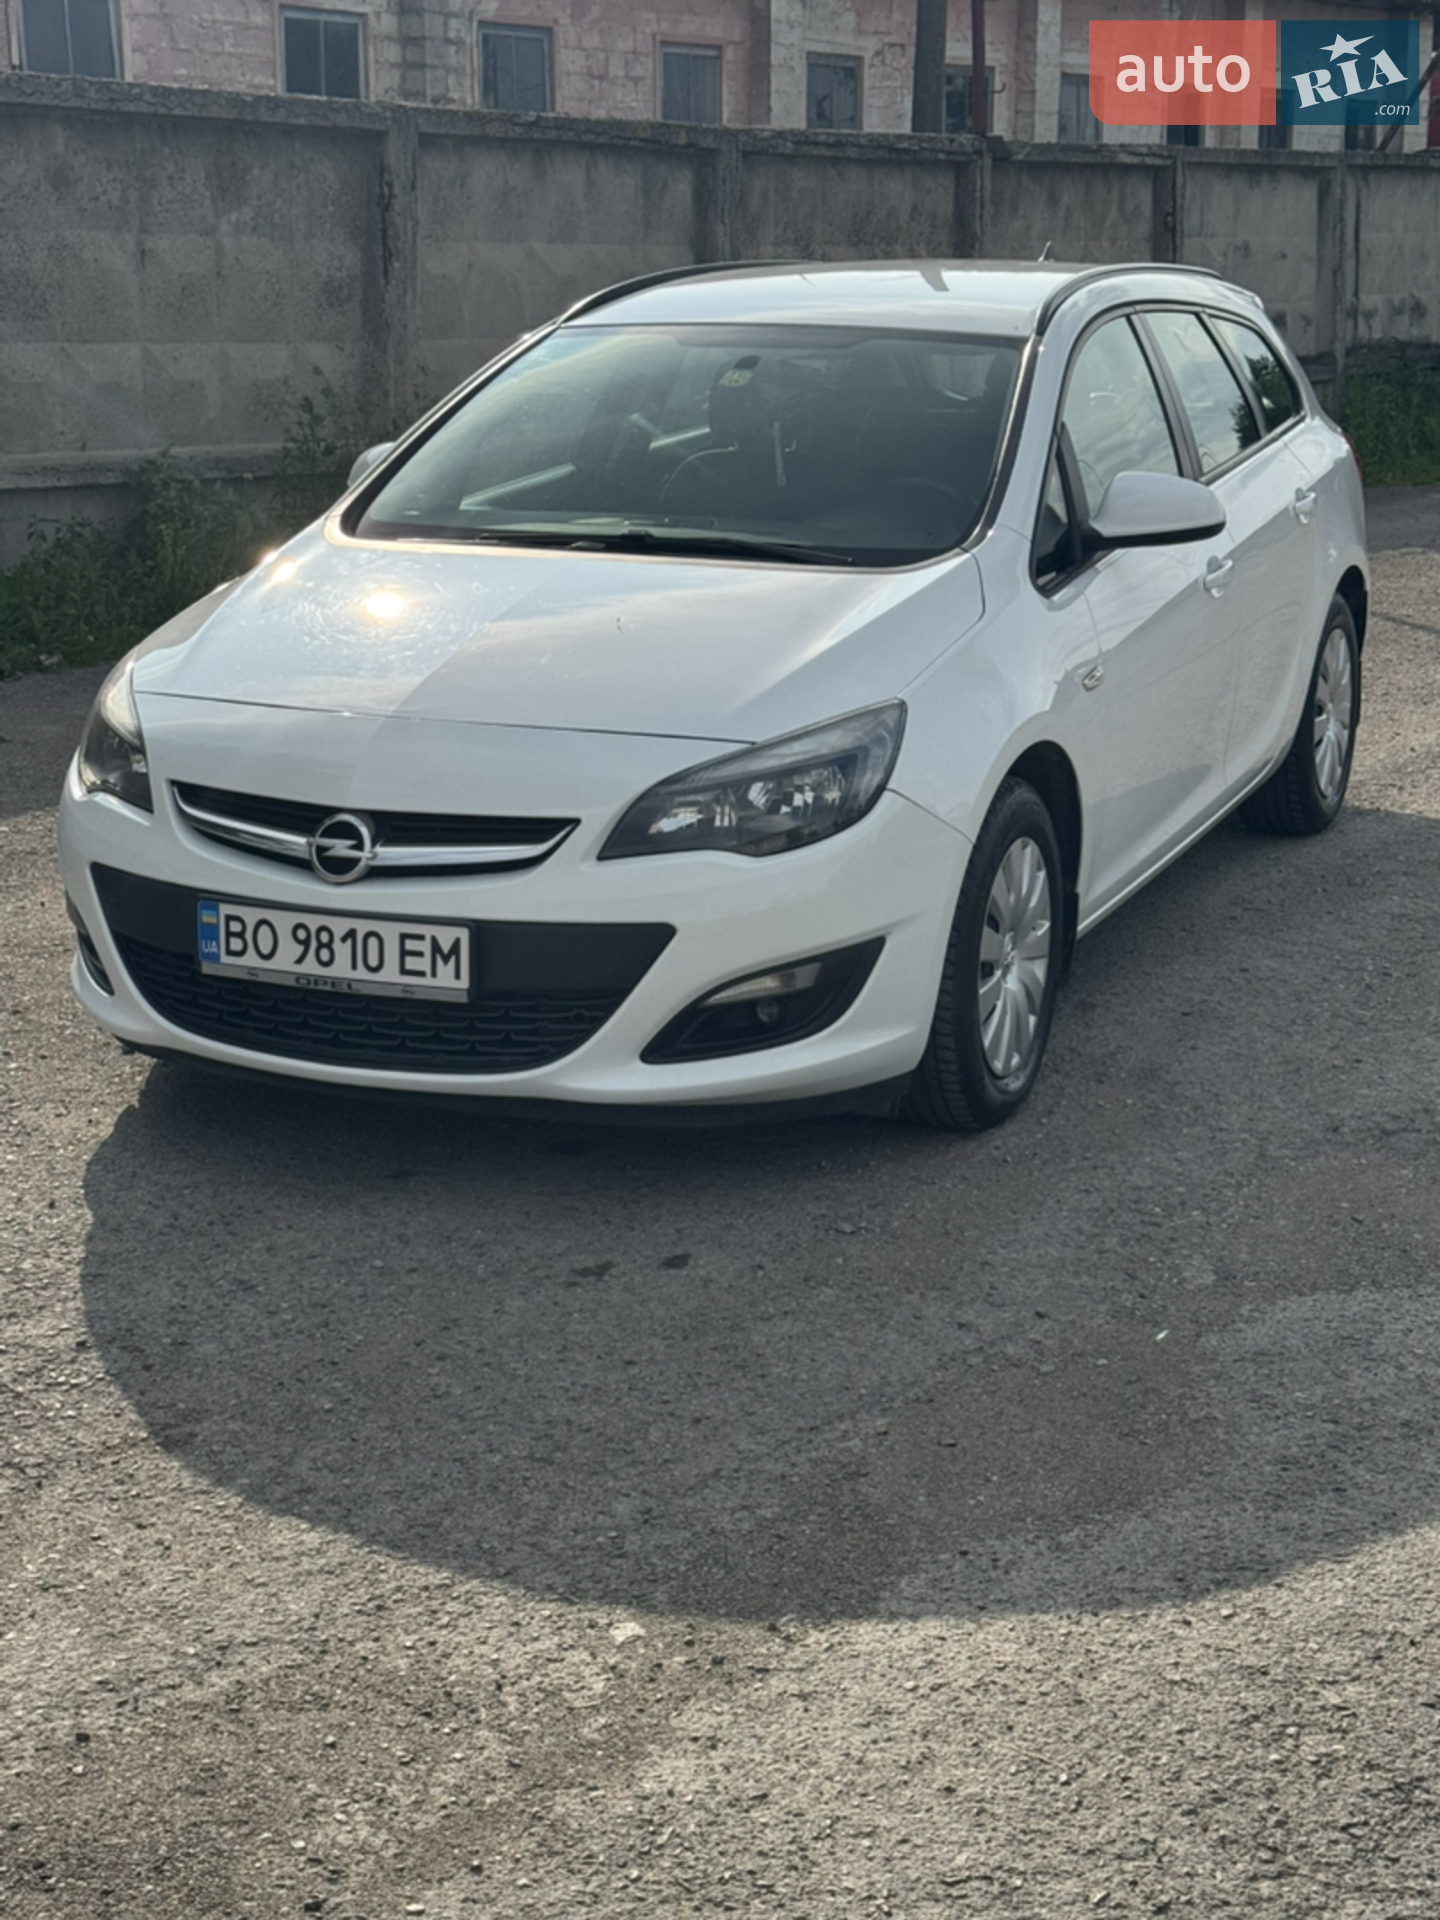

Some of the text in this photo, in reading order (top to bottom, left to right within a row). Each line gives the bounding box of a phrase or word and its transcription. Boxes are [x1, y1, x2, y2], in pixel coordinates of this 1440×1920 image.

[201, 939, 219, 954] UA
[224, 913, 461, 981] BO 9810 EM
[295, 975, 361, 993] OPEL
